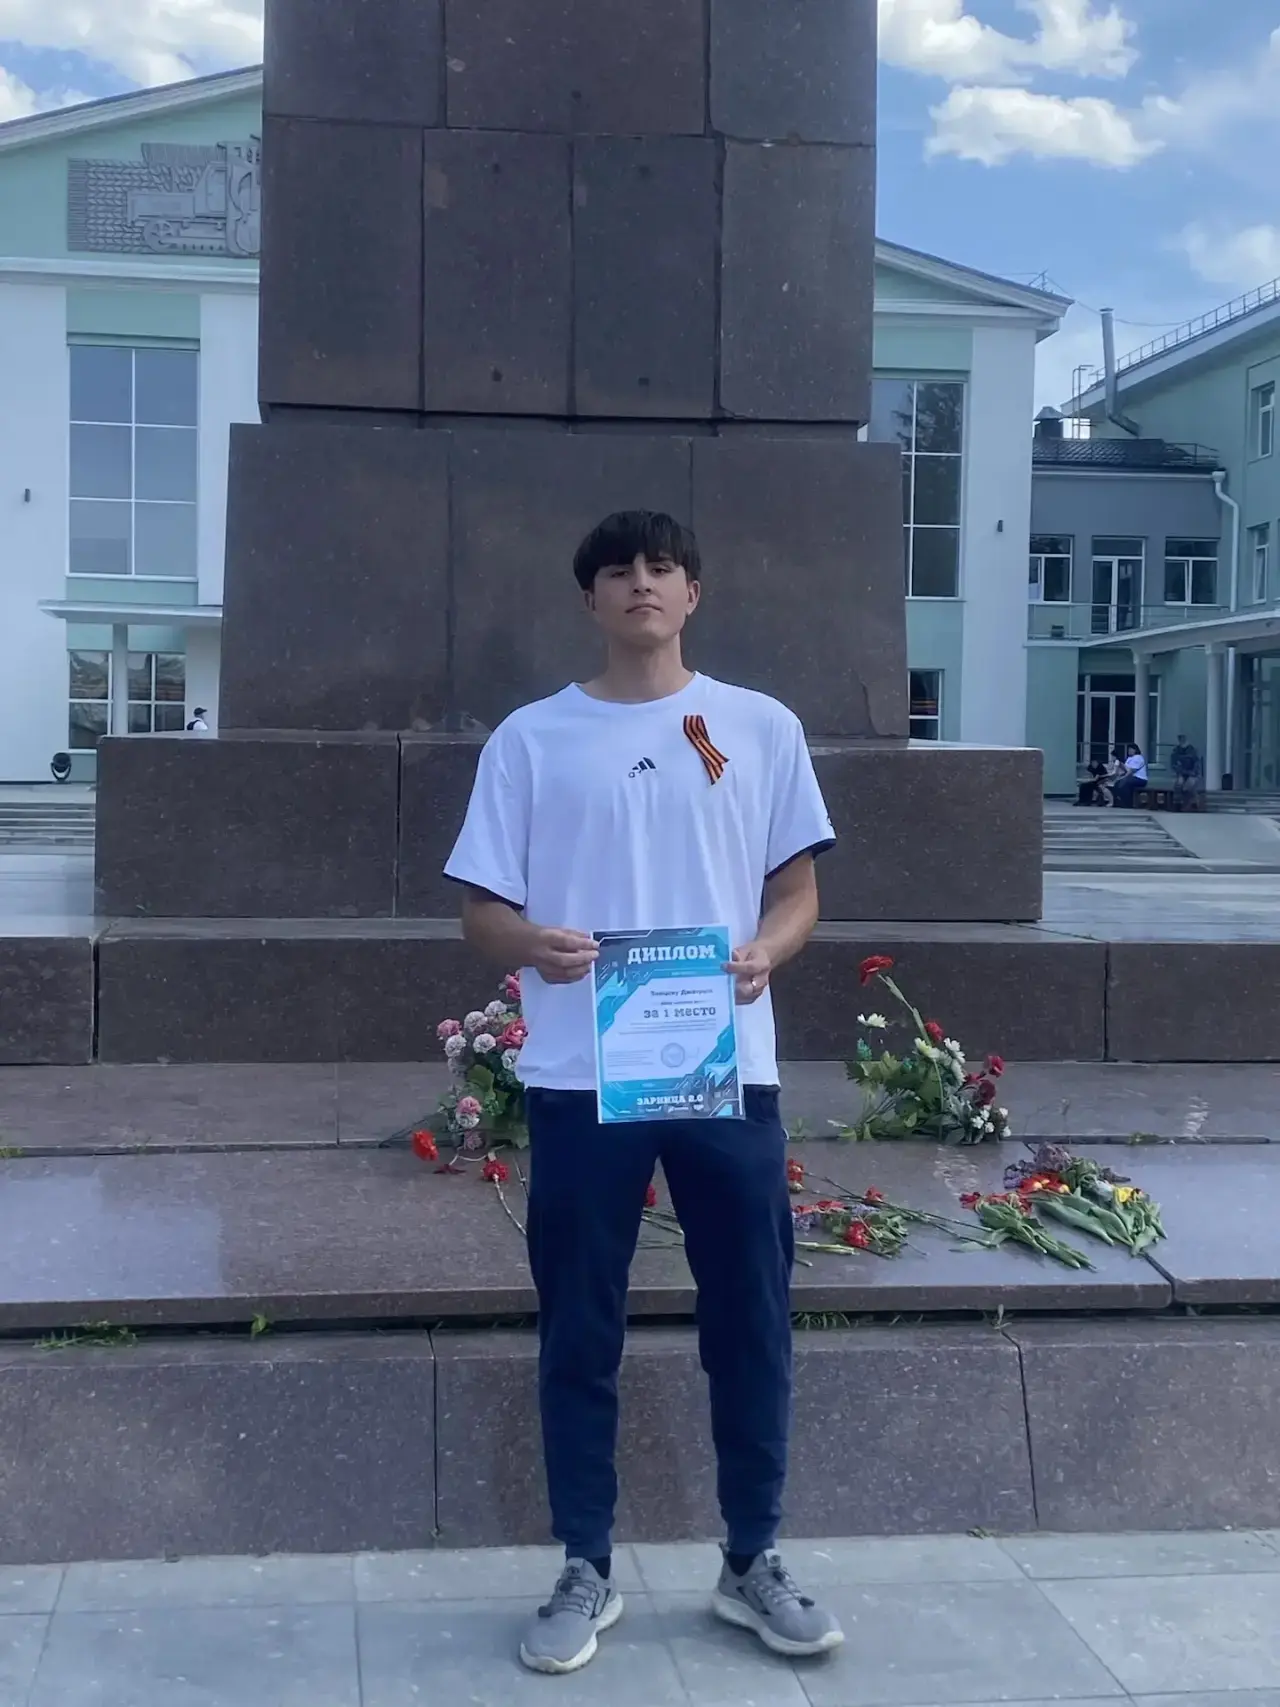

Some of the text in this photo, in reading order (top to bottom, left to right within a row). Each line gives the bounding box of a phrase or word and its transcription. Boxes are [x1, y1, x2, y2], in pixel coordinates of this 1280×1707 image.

[627, 944, 716, 965] ДИПЛОМ
[663, 1008, 670, 1018] 1
[636, 1094, 686, 1106] ЗАРНИЦА
